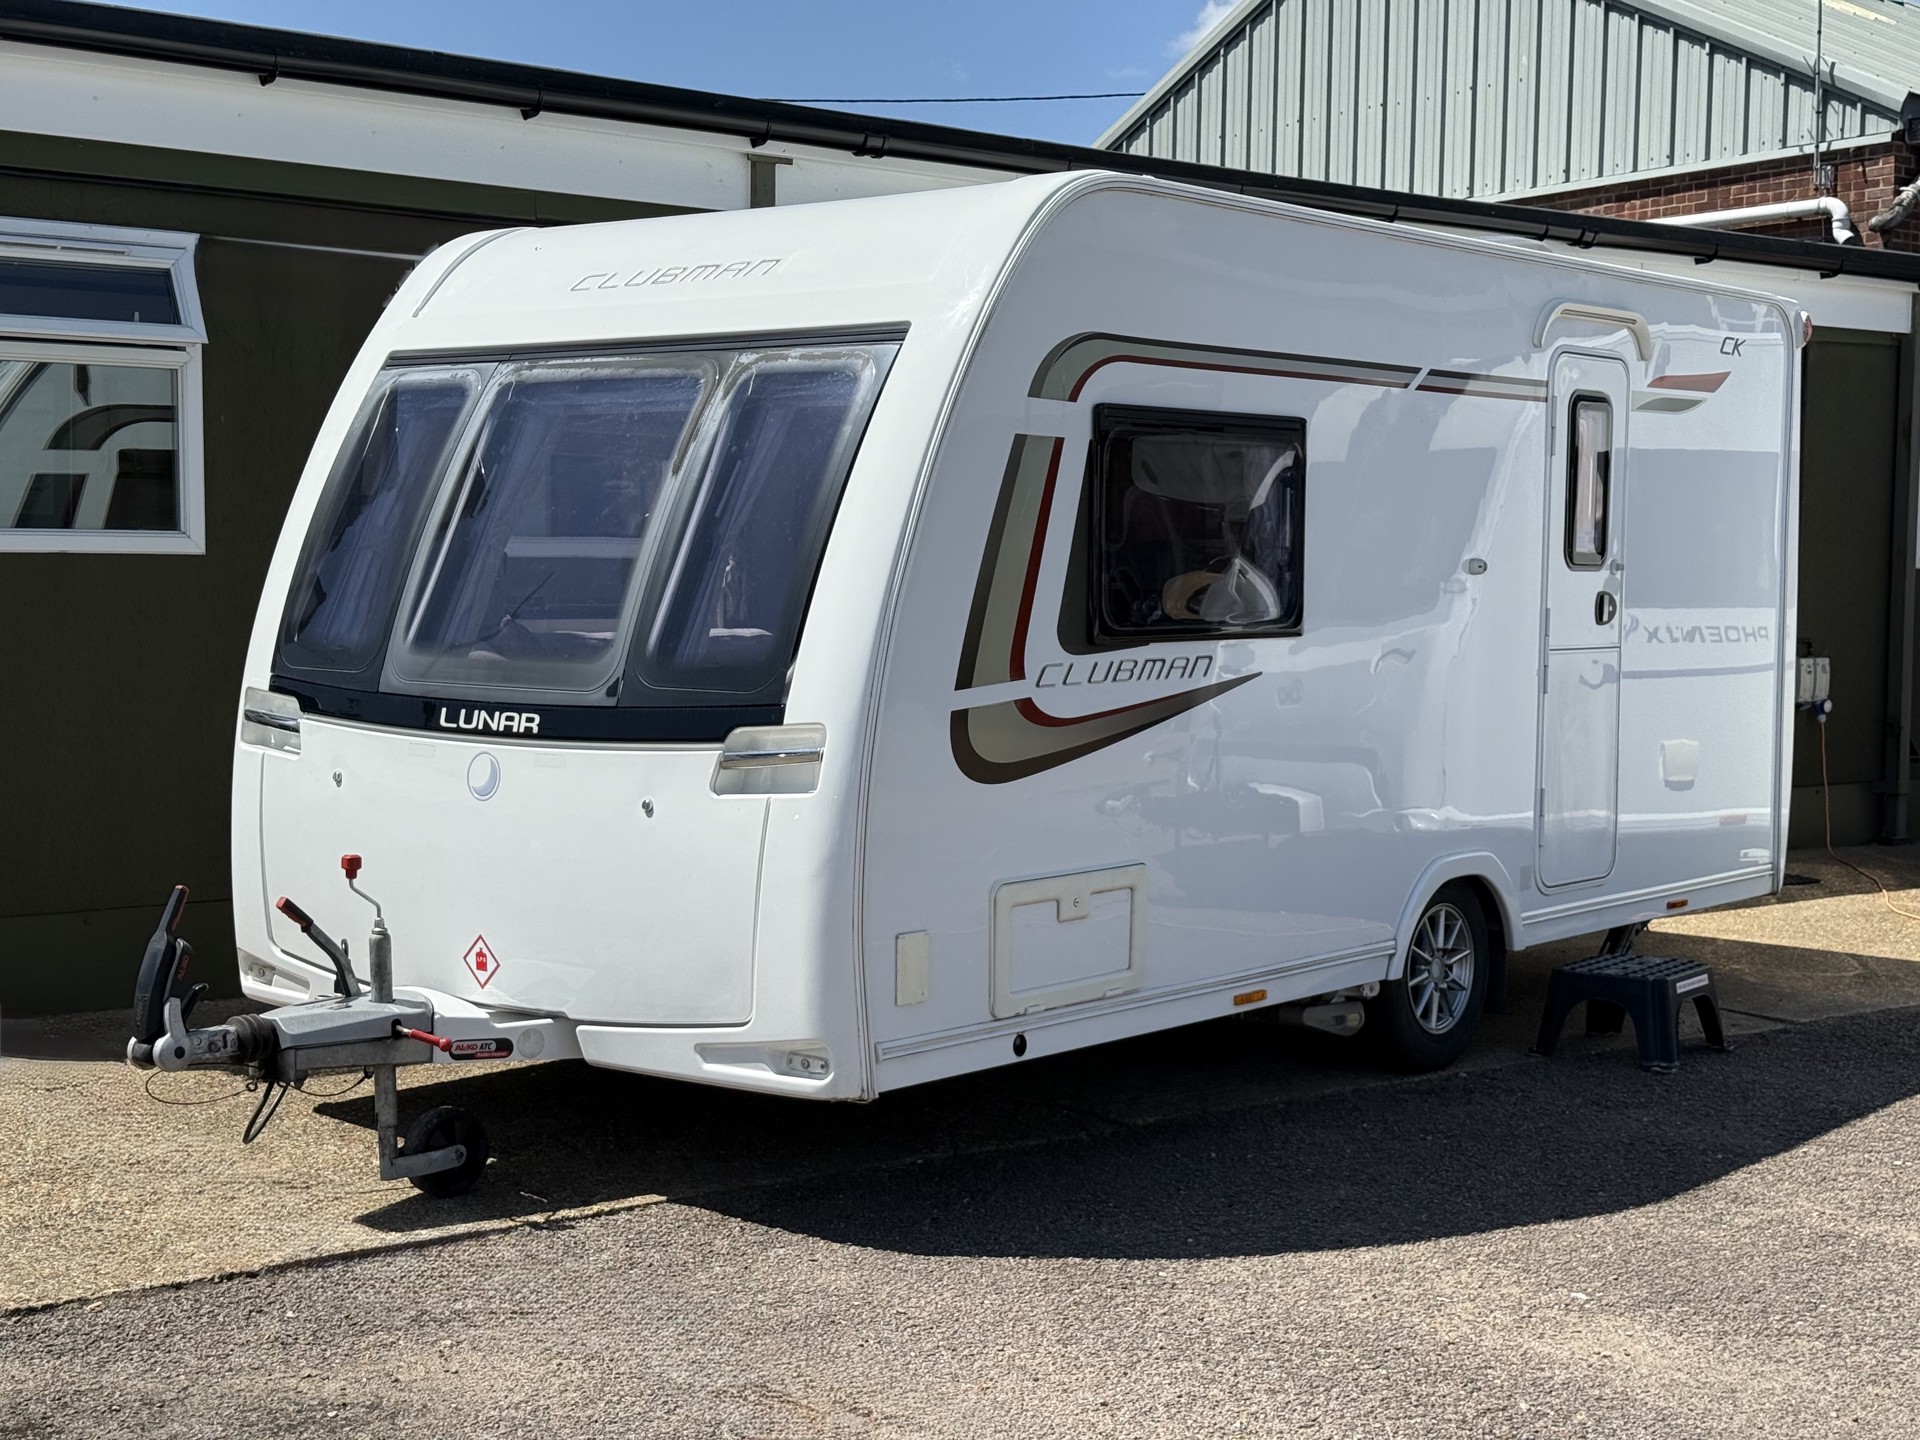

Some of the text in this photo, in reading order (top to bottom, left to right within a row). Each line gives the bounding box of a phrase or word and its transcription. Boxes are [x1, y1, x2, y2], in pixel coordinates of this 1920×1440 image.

[569, 258, 782, 291] CLUBMAN
[1720, 336, 1747, 357] CK
[1035, 655, 1213, 688] CLUBMAN
[439, 707, 541, 734] LUNAR
[479, 1042, 493, 1050] ATC
